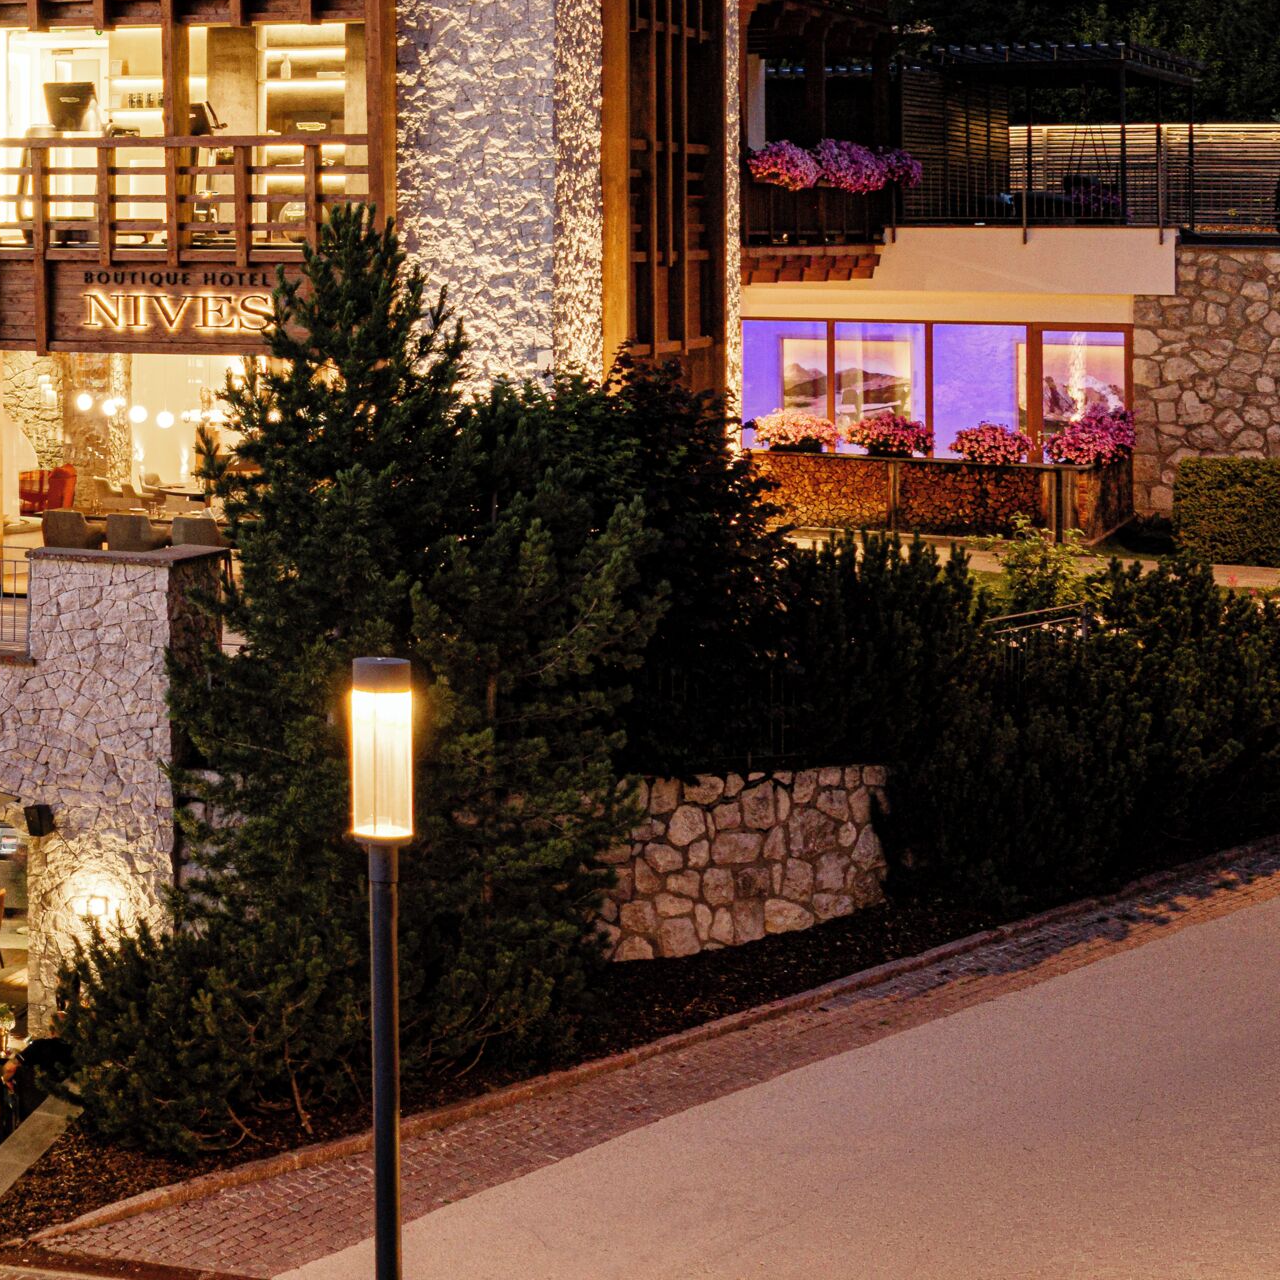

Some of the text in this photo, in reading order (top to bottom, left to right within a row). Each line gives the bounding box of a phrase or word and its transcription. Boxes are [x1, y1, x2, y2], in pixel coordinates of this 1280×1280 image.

[84, 270, 272, 287] BOUTIQUE HOTEL
[83, 292, 276, 331] NIVES
